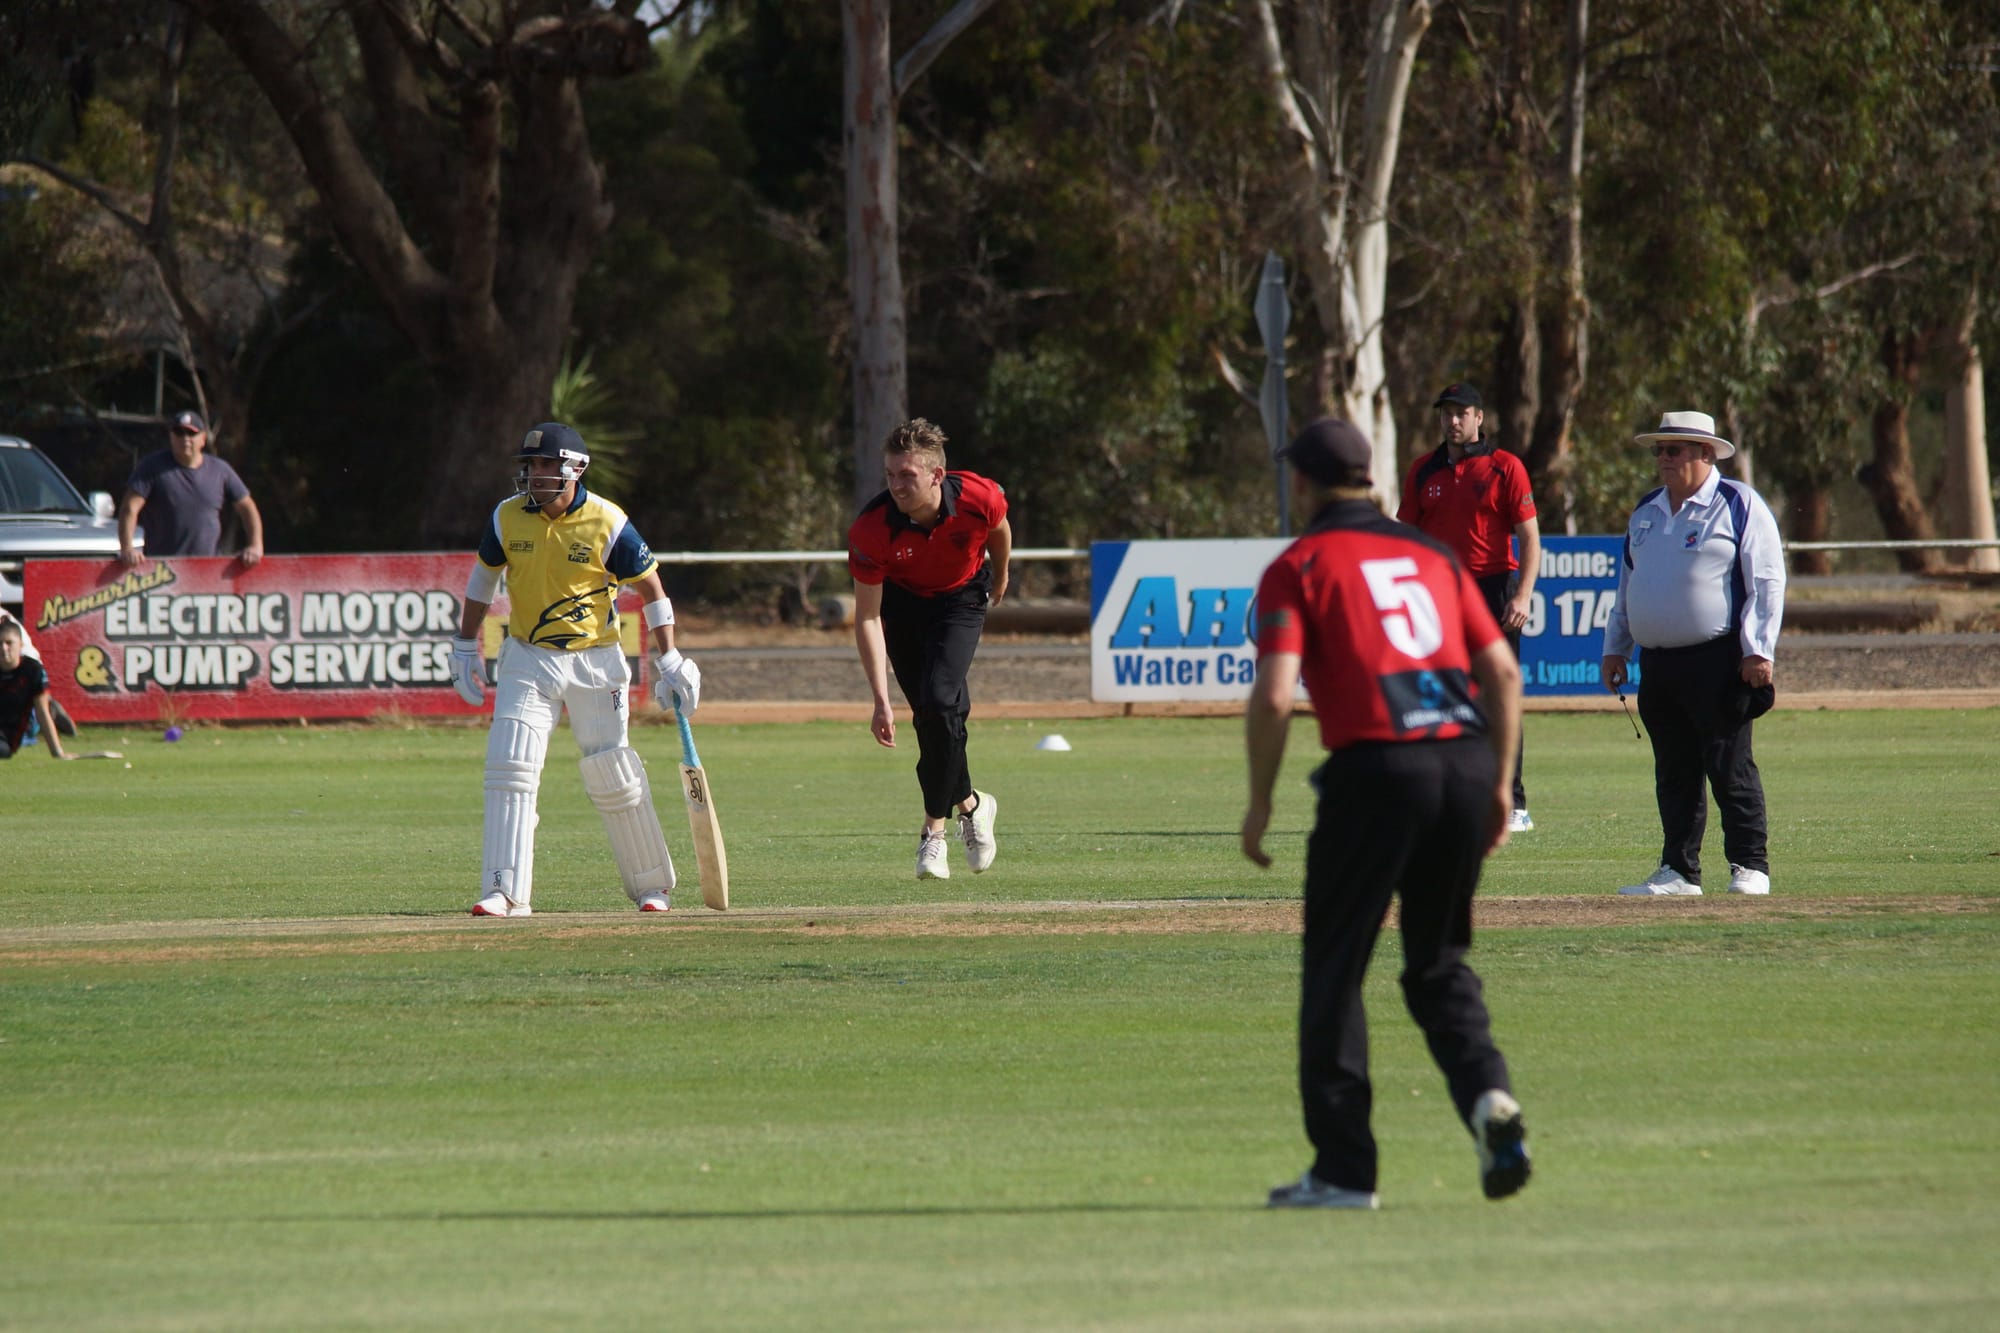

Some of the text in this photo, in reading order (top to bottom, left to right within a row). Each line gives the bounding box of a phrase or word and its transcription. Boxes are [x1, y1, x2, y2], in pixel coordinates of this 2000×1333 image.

[1540, 550, 1616, 578] hone:
[105, 593, 285, 636] ELECTRIC
[301, 591, 456, 633] MOTOR
[1109, 577, 1257, 648] AH
[1360, 556, 1443, 660] 5
[1521, 590, 1546, 637] 9
[76, 646, 110, 687] &
[124, 646, 255, 686] PUMP
[270, 642, 455, 684] SERVICES
[1114, 653, 1254, 685] Water Ca
[1537, 659, 1601, 686] Lynda
